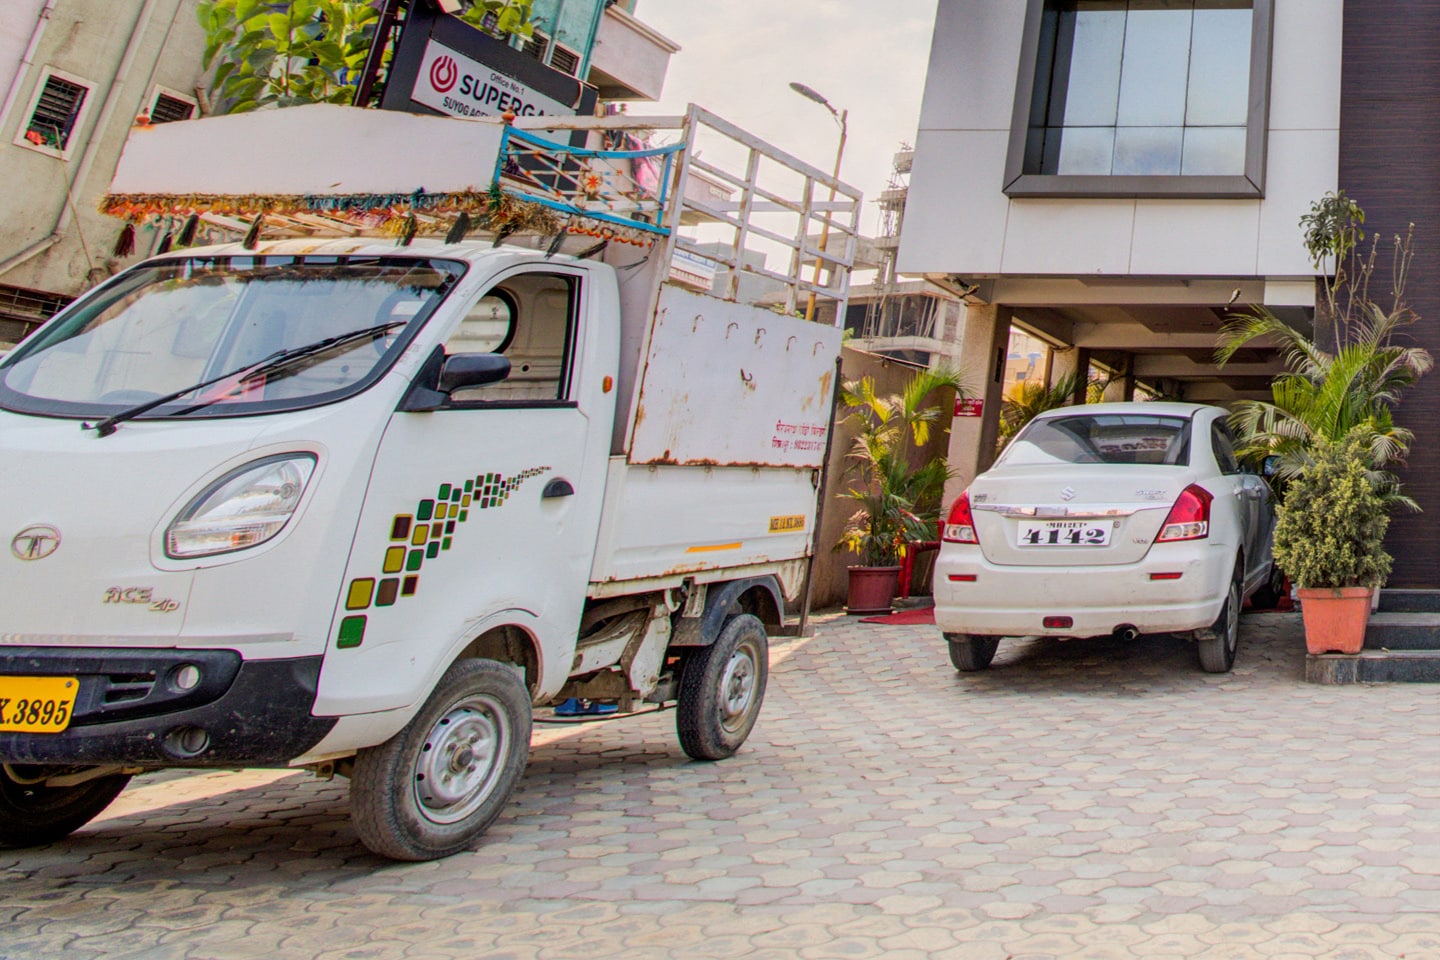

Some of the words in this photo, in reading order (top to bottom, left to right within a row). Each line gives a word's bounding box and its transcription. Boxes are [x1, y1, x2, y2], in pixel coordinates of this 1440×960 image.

[490, 72, 508, 88] Office
[443, 96, 469, 117] SUYOG
[459, 74, 556, 133] SUPERG
[1023, 528, 1105, 545] 4142
[103, 586, 153, 604] ACE
